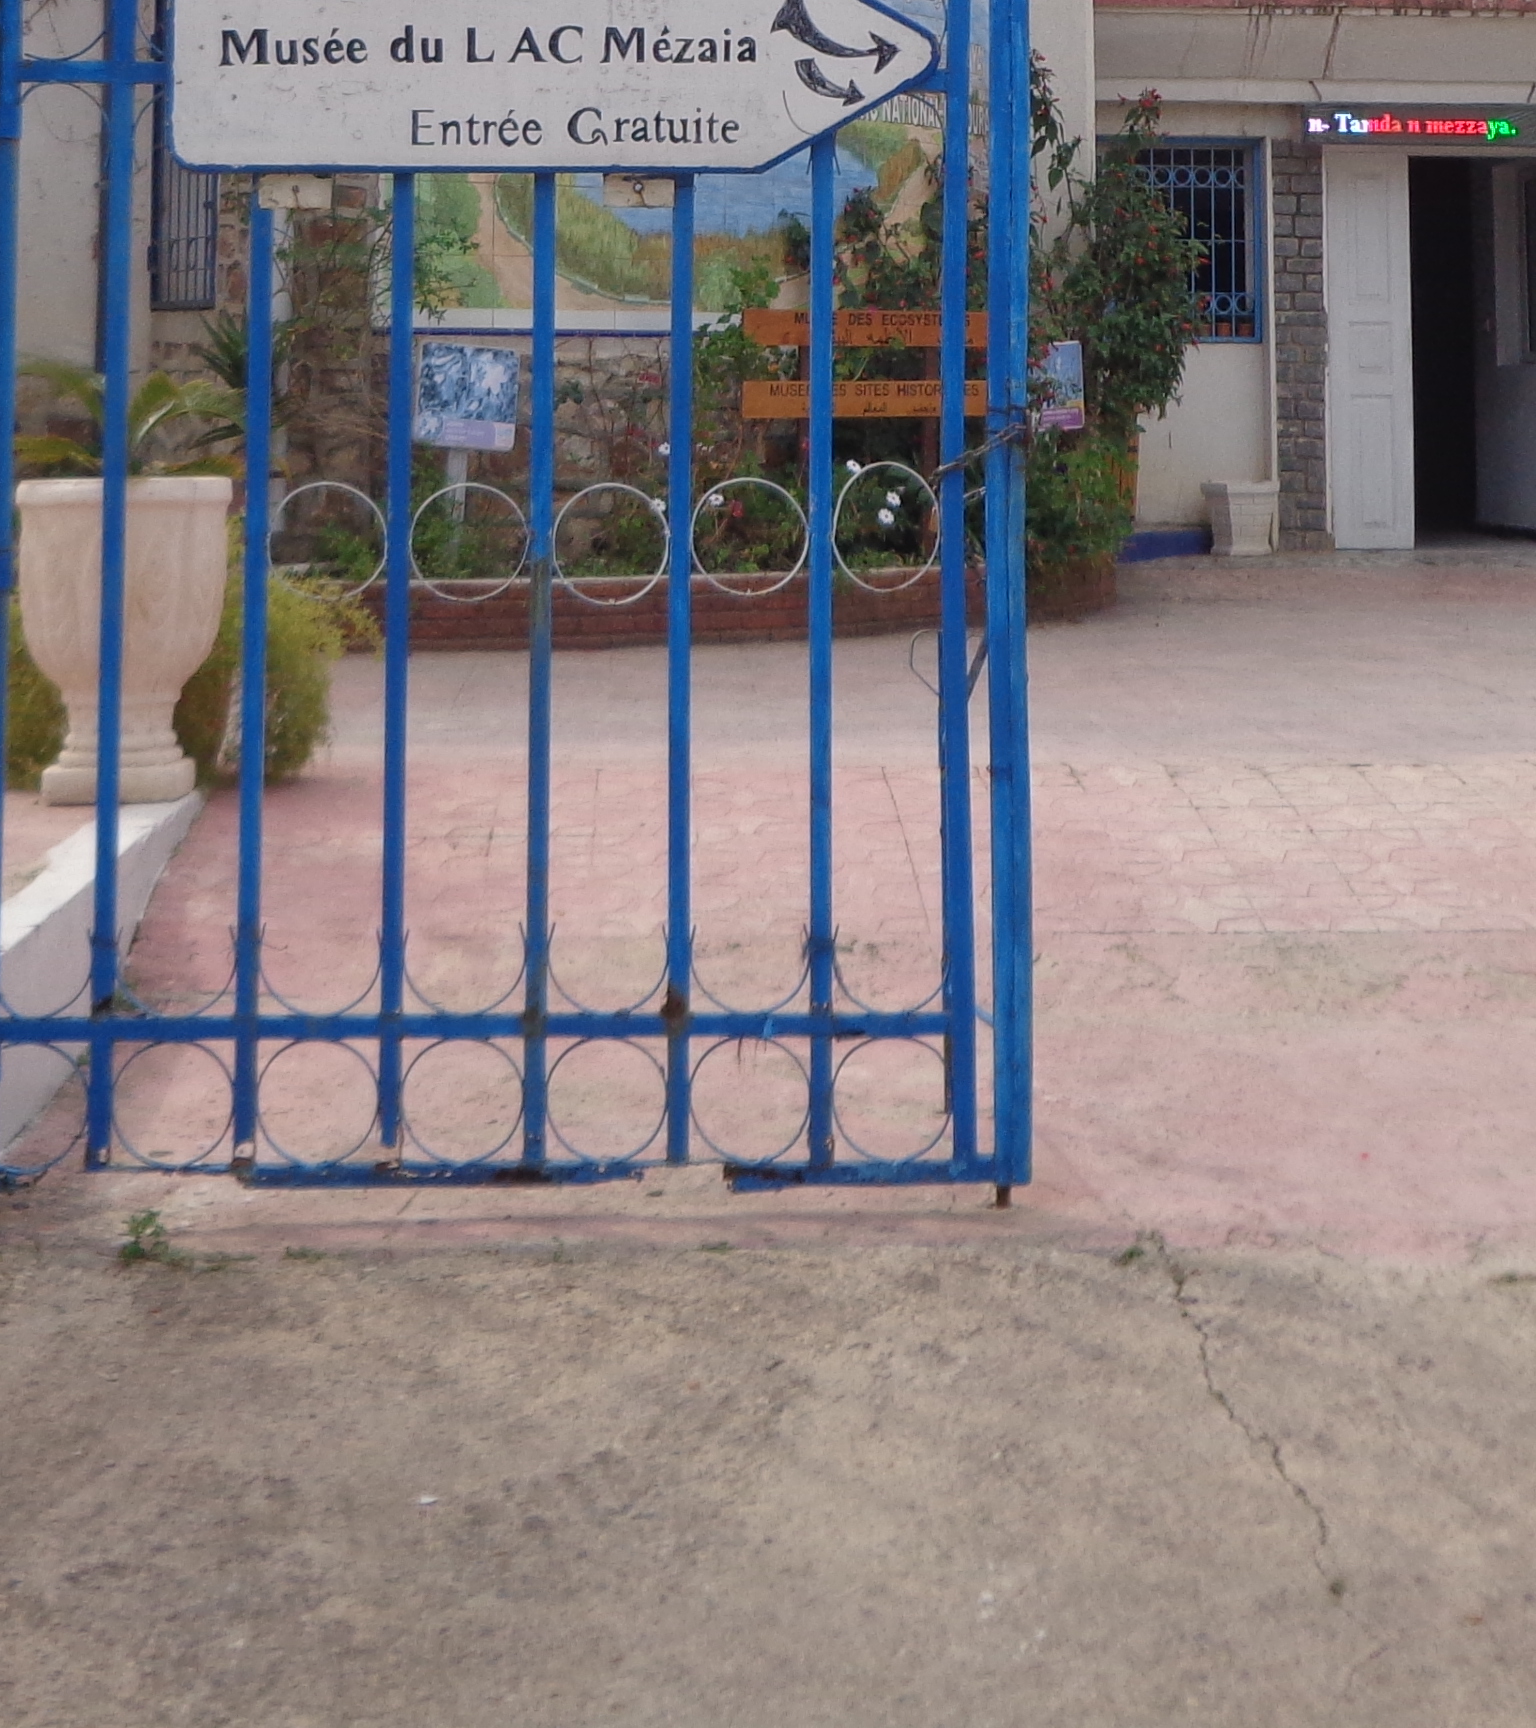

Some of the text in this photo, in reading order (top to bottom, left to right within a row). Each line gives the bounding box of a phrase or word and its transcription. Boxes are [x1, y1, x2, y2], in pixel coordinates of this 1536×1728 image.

[217, 27, 369, 66] Musée
[389, 25, 444, 64] du
[599, 25, 758, 65] Mézaia
[410, 107, 741, 147] Entrée Gratuite
[1334, 113, 1402, 134] Tamda
[1407, 119, 1421, 134] n
[847, 313, 873, 326] DES
[854, 383, 890, 396] SITES
